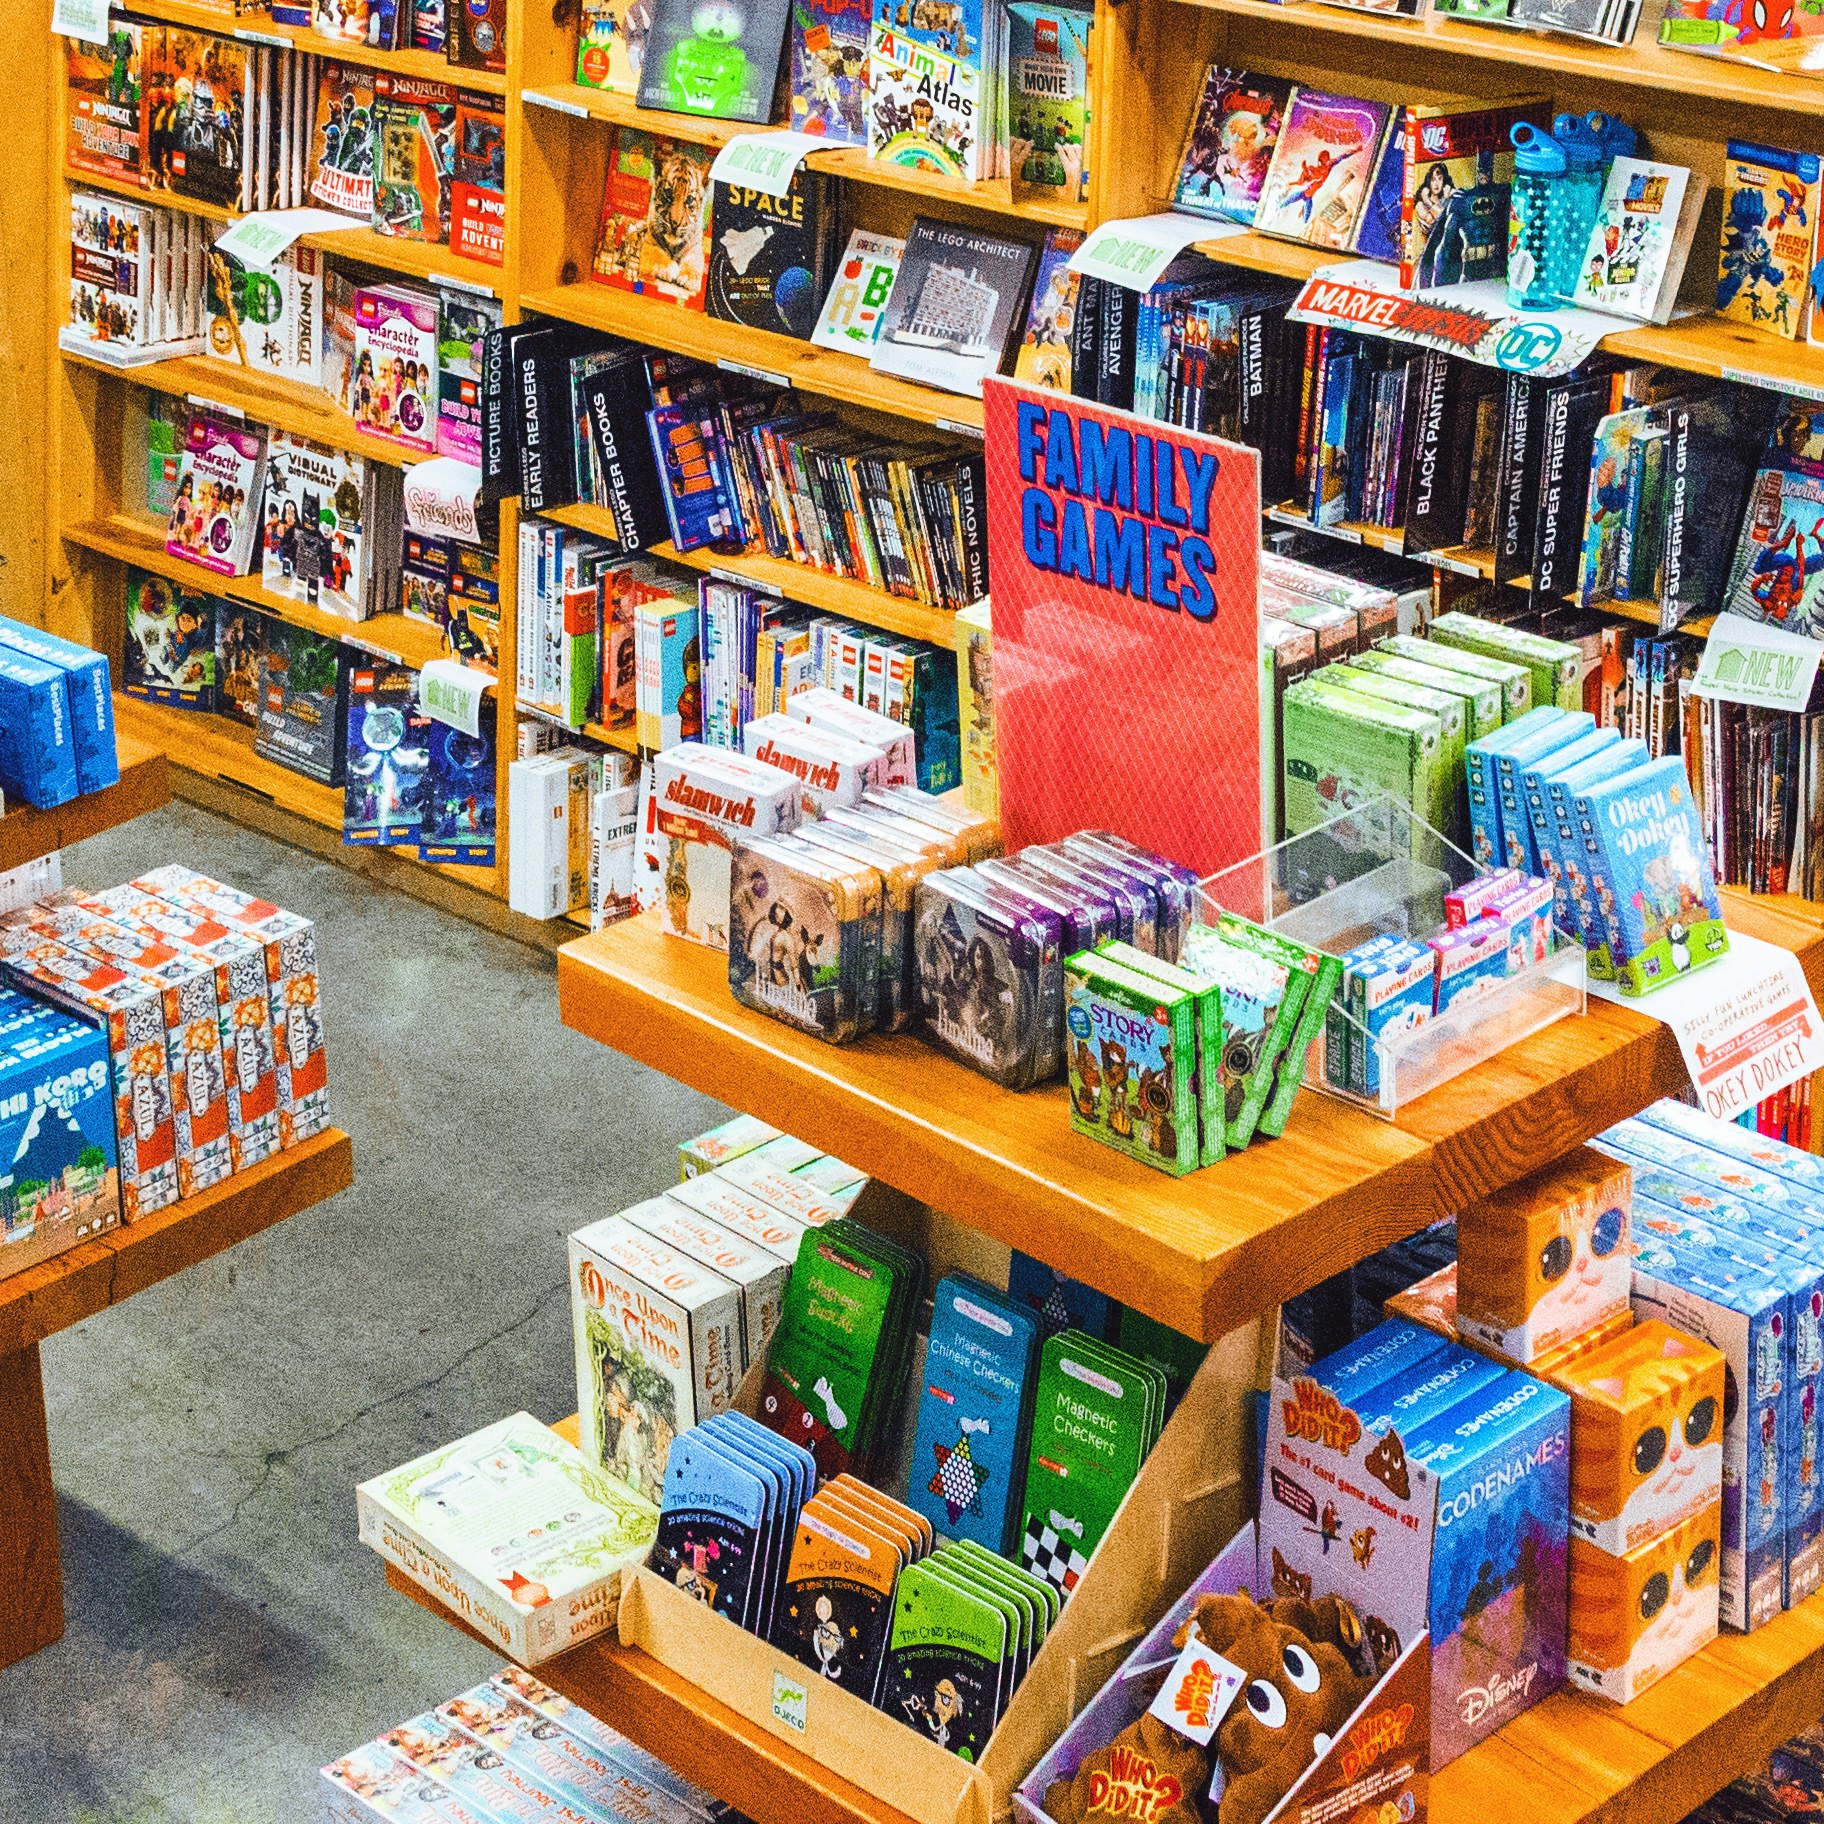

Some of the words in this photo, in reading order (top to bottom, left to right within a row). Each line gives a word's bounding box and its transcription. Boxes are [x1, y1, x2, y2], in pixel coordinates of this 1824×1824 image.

[880, 31, 958, 87] Animal
[1024, 70, 1067, 97] MOVIE
[915, 74, 975, 118] Atlas
[729, 189, 805, 215] SPACE
[1308, 286, 1399, 328] MARVEL
[489, 331, 503, 395] BOOKS
[1247, 313, 1265, 397] BATMAN
[1504, 328, 1559, 367] DC
[520, 358, 540, 454] READERS
[593, 391, 622, 461] BOOKS
[1424, 352, 1448, 458] PANTHER
[486, 403, 503, 477] PICTURE
[1016, 400, 1220, 535] FAMILY
[1548, 392, 1569, 491] FRIENDS
[1675, 413, 1691, 472] GIRLS
[528, 459, 545, 511] EARLY
[616, 464, 641, 551] CHAPTER
[1416, 460, 1437, 516] BLACK
[1021, 491, 1220, 621] GAMES
[1541, 495, 1561, 560] SUPER
[1668, 472, 1686, 590] SUPERHERO
[1539, 564, 1554, 593] DC
[755, 739, 841, 792] slamwich
[666, 772, 757, 832] slamwich
[1090, 1004, 1155, 1046] STORY
[33, 1059, 109, 1109] KORO
[1707, 1075, 1747, 1118] OKEY
[1750, 1047, 1810, 1095] DOKEY
[1053, 1416, 1117, 1456] Checkers
[1057, 1392, 1118, 1432] Magnetic
[1439, 1431, 1566, 1527] CODENAMES
